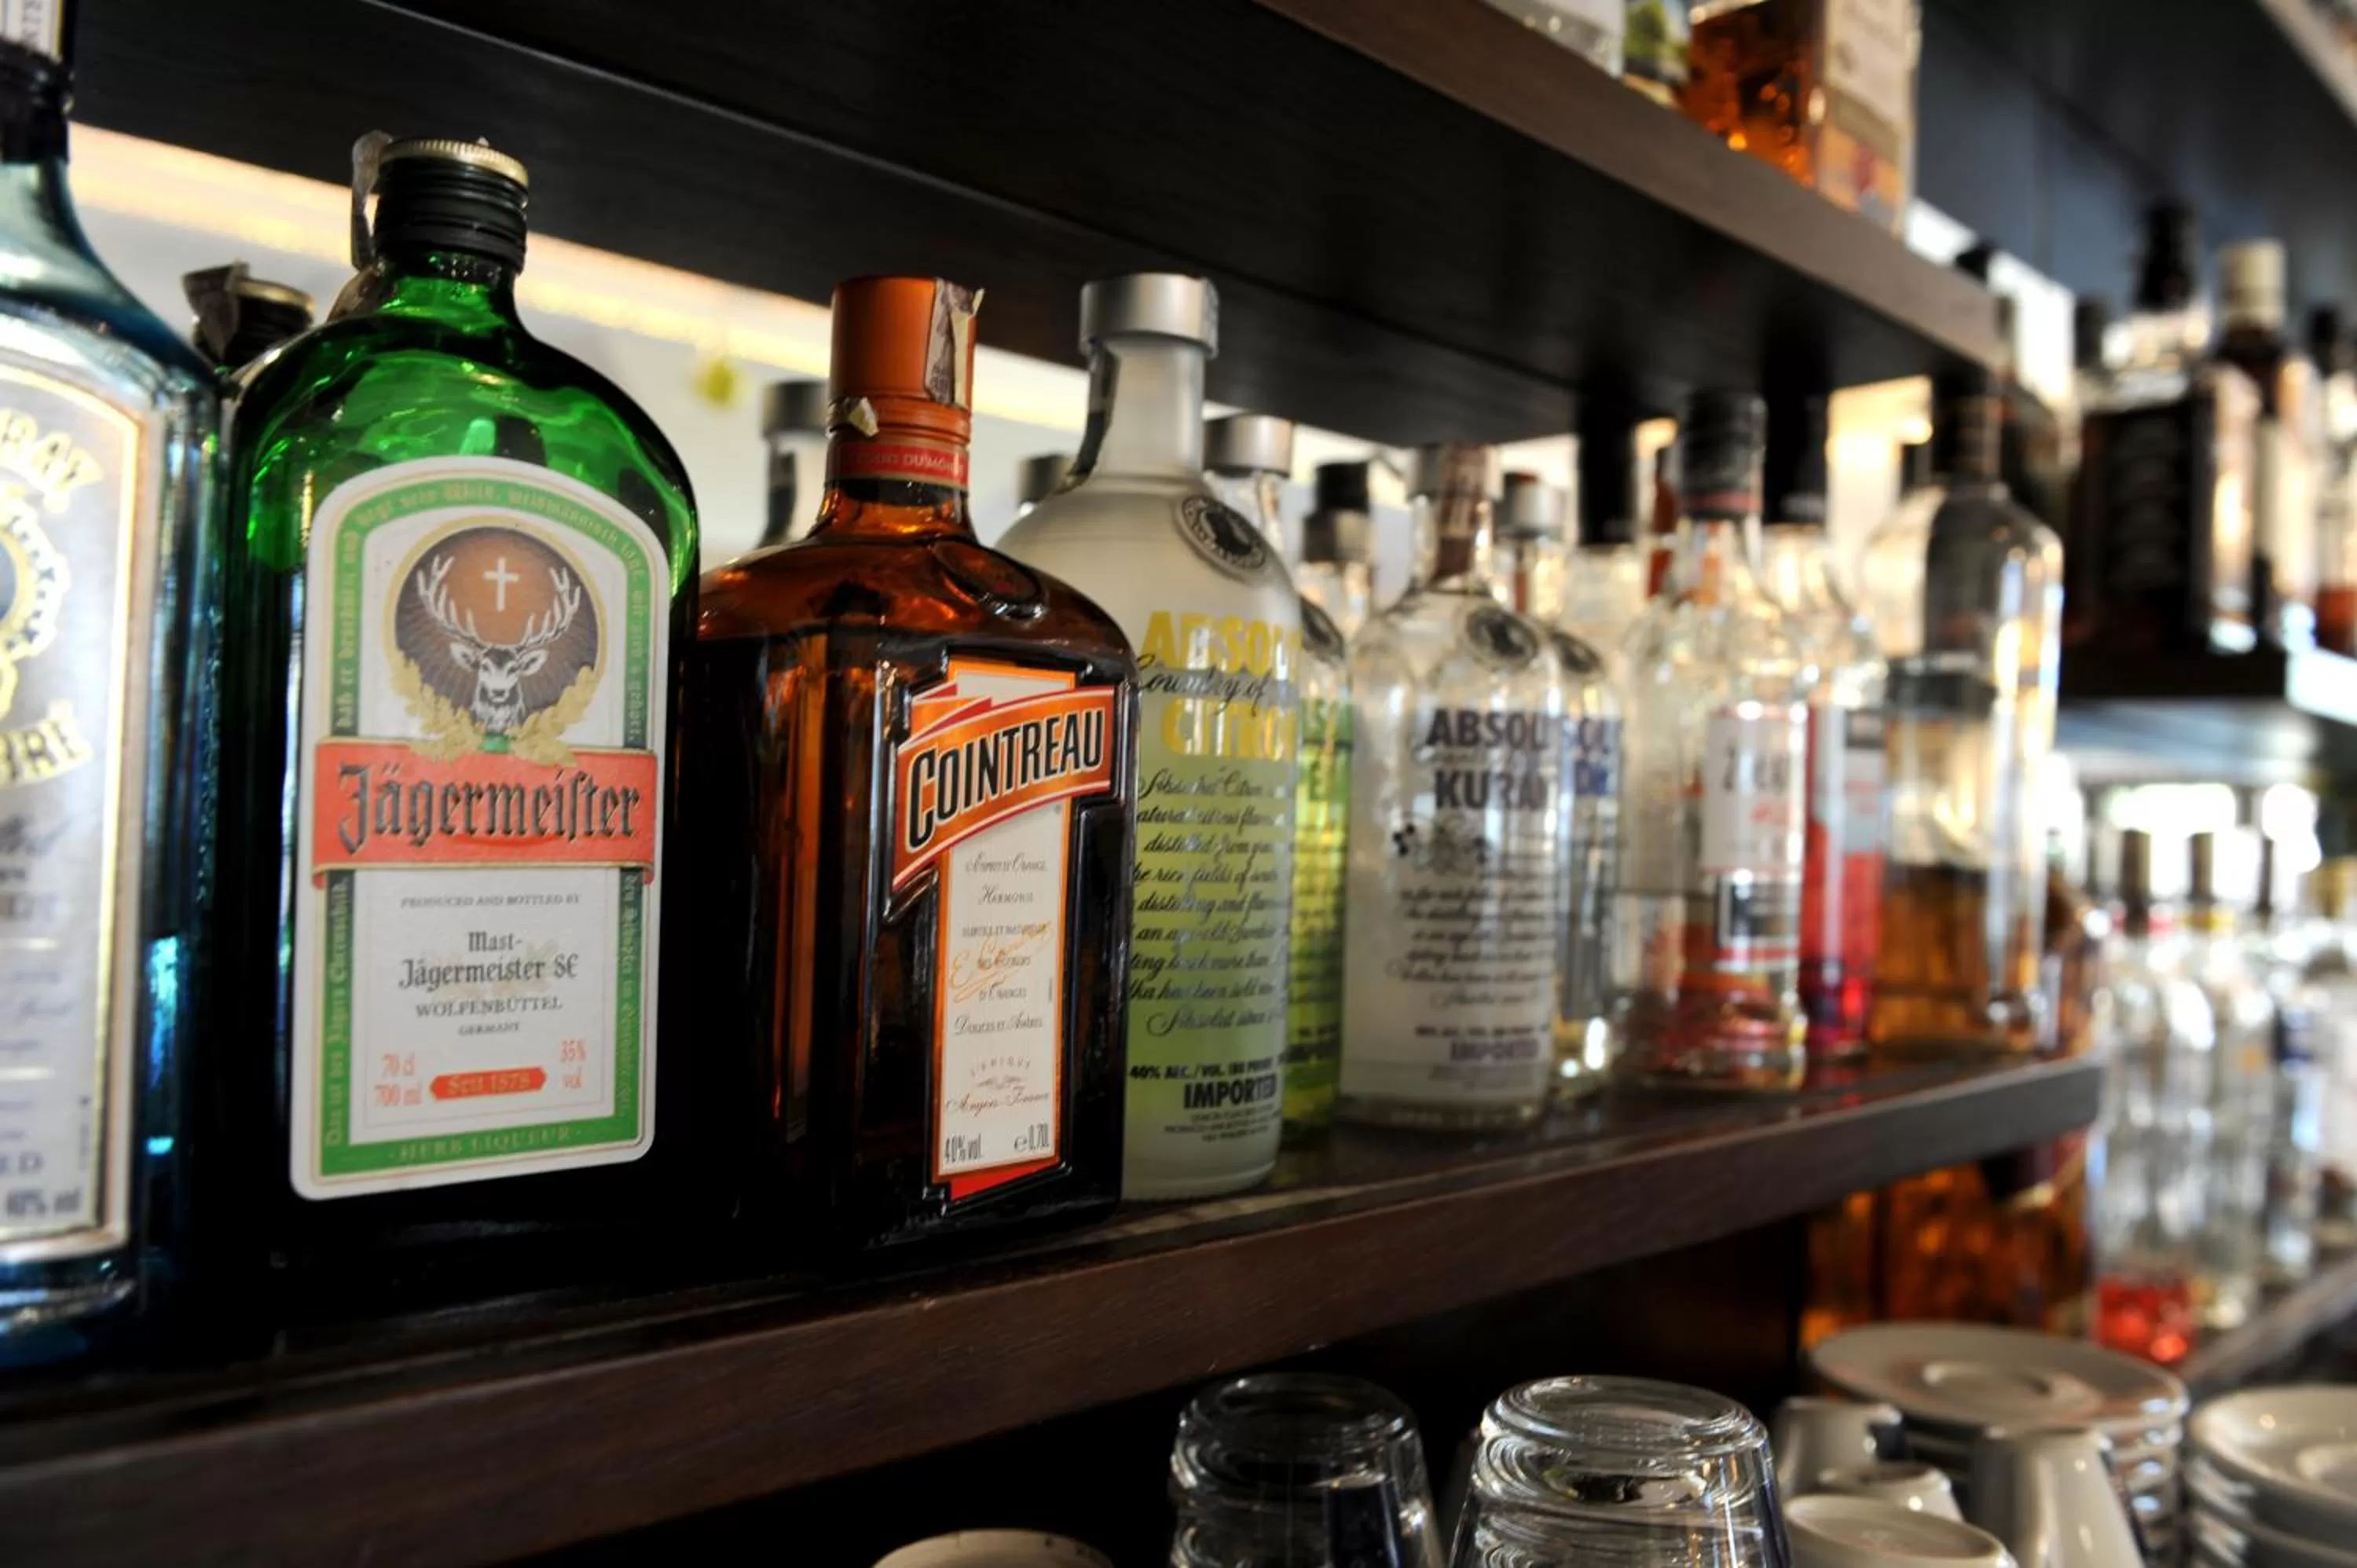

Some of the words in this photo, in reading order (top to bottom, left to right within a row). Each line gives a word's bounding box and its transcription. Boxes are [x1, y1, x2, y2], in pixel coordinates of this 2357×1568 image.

[907, 706, 1105, 854] COINTREAU
[475, 894, 504, 906] AND
[506, 892, 563, 906] BOTTLED
[565, 892, 581, 904] BY
[467, 930, 523, 953] Mast-
[398, 954, 547, 993] Jägermeister
